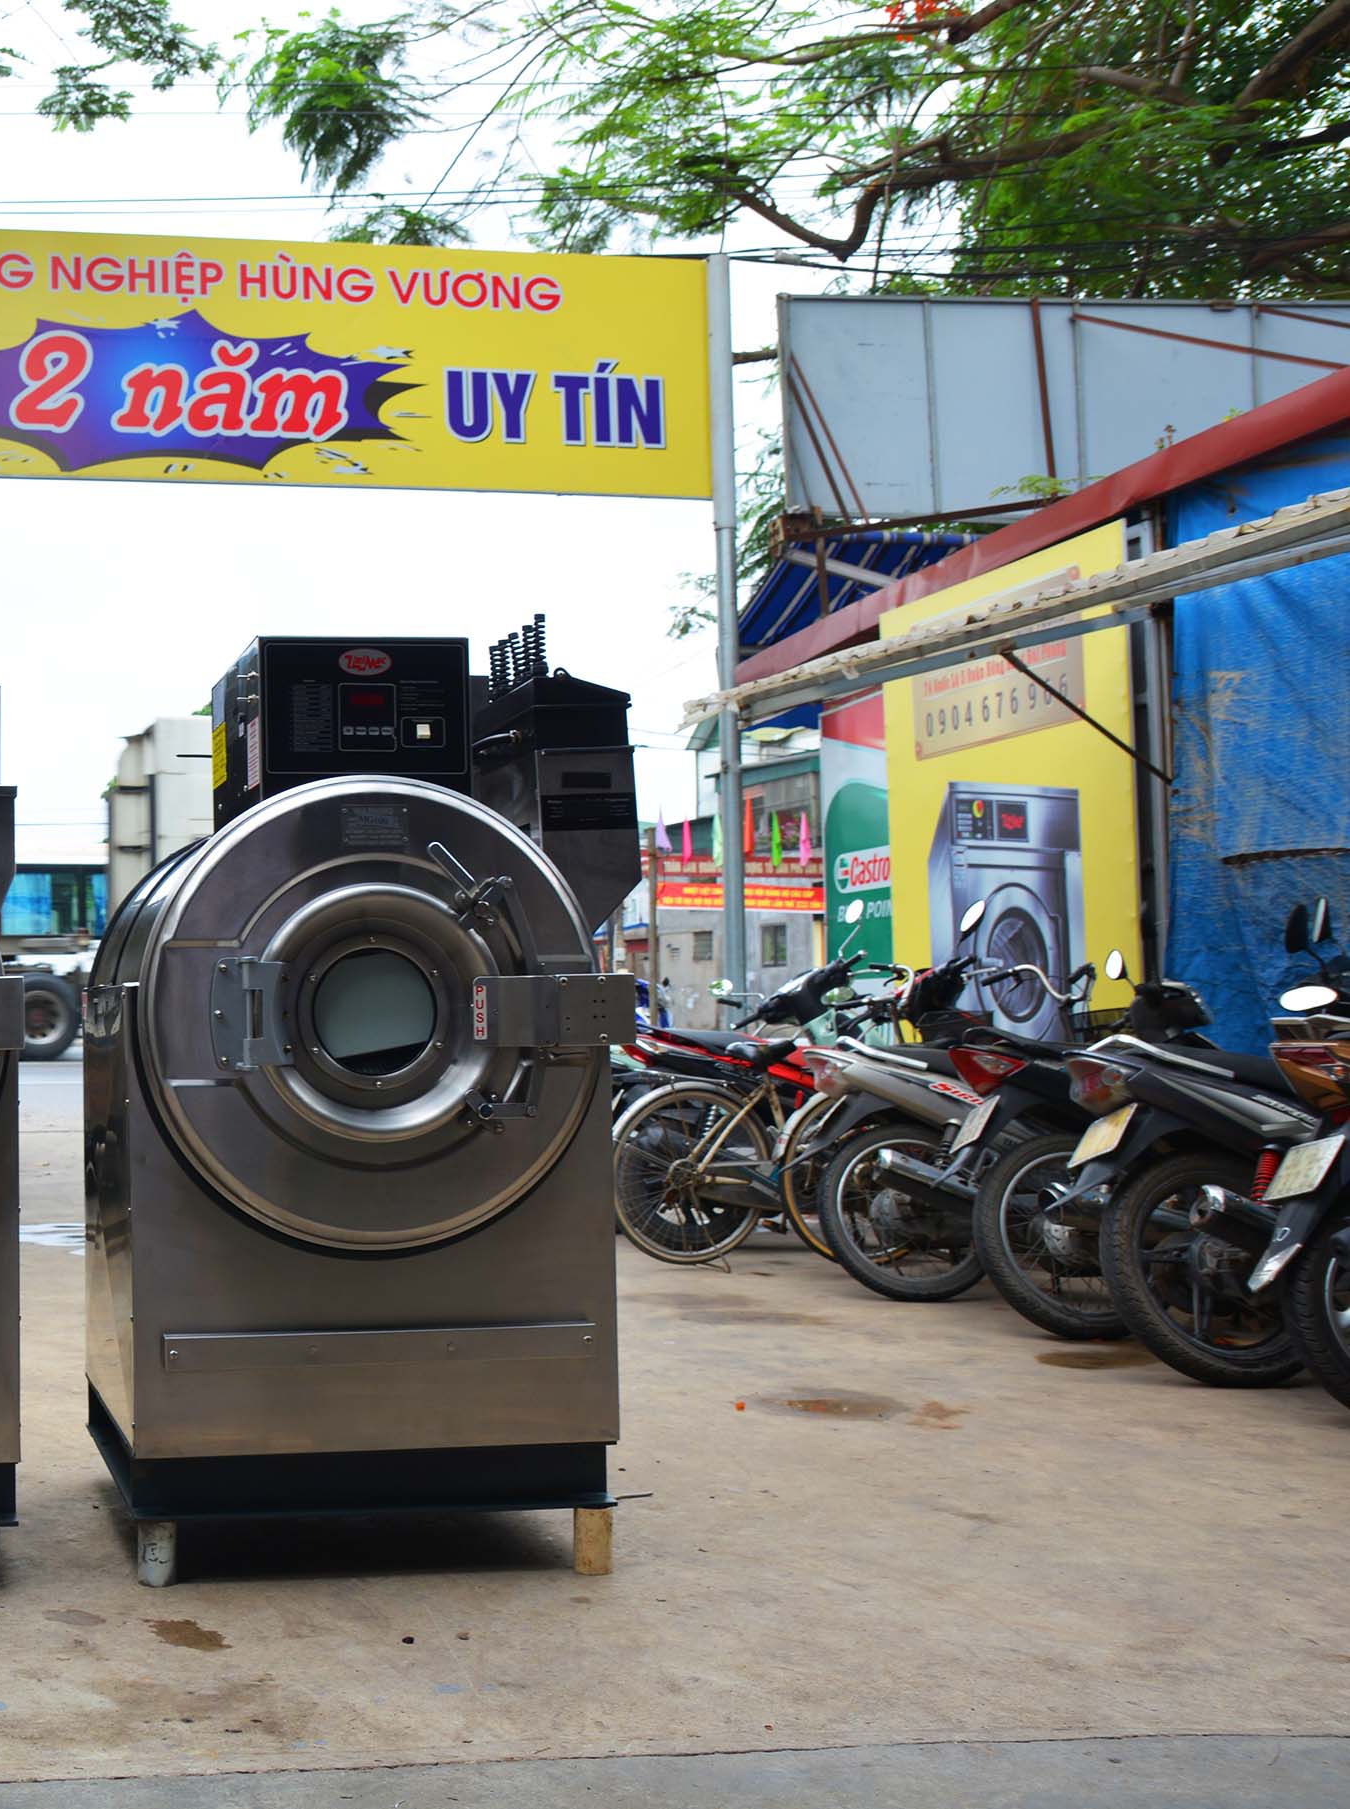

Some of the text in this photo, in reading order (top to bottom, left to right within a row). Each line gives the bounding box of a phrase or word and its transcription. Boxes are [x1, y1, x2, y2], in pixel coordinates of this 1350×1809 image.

[49, 252, 224, 304] NGHIỆP
[238, 253, 374, 304] HÙNG
[388, 267, 562, 313] VƯƠNG
[8, 329, 93, 434] 2
[111, 339, 350, 442] năm
[443, 366, 537, 445] UY
[551, 358, 667, 450] TÍN
[475, 985, 485, 1038] PUSH
